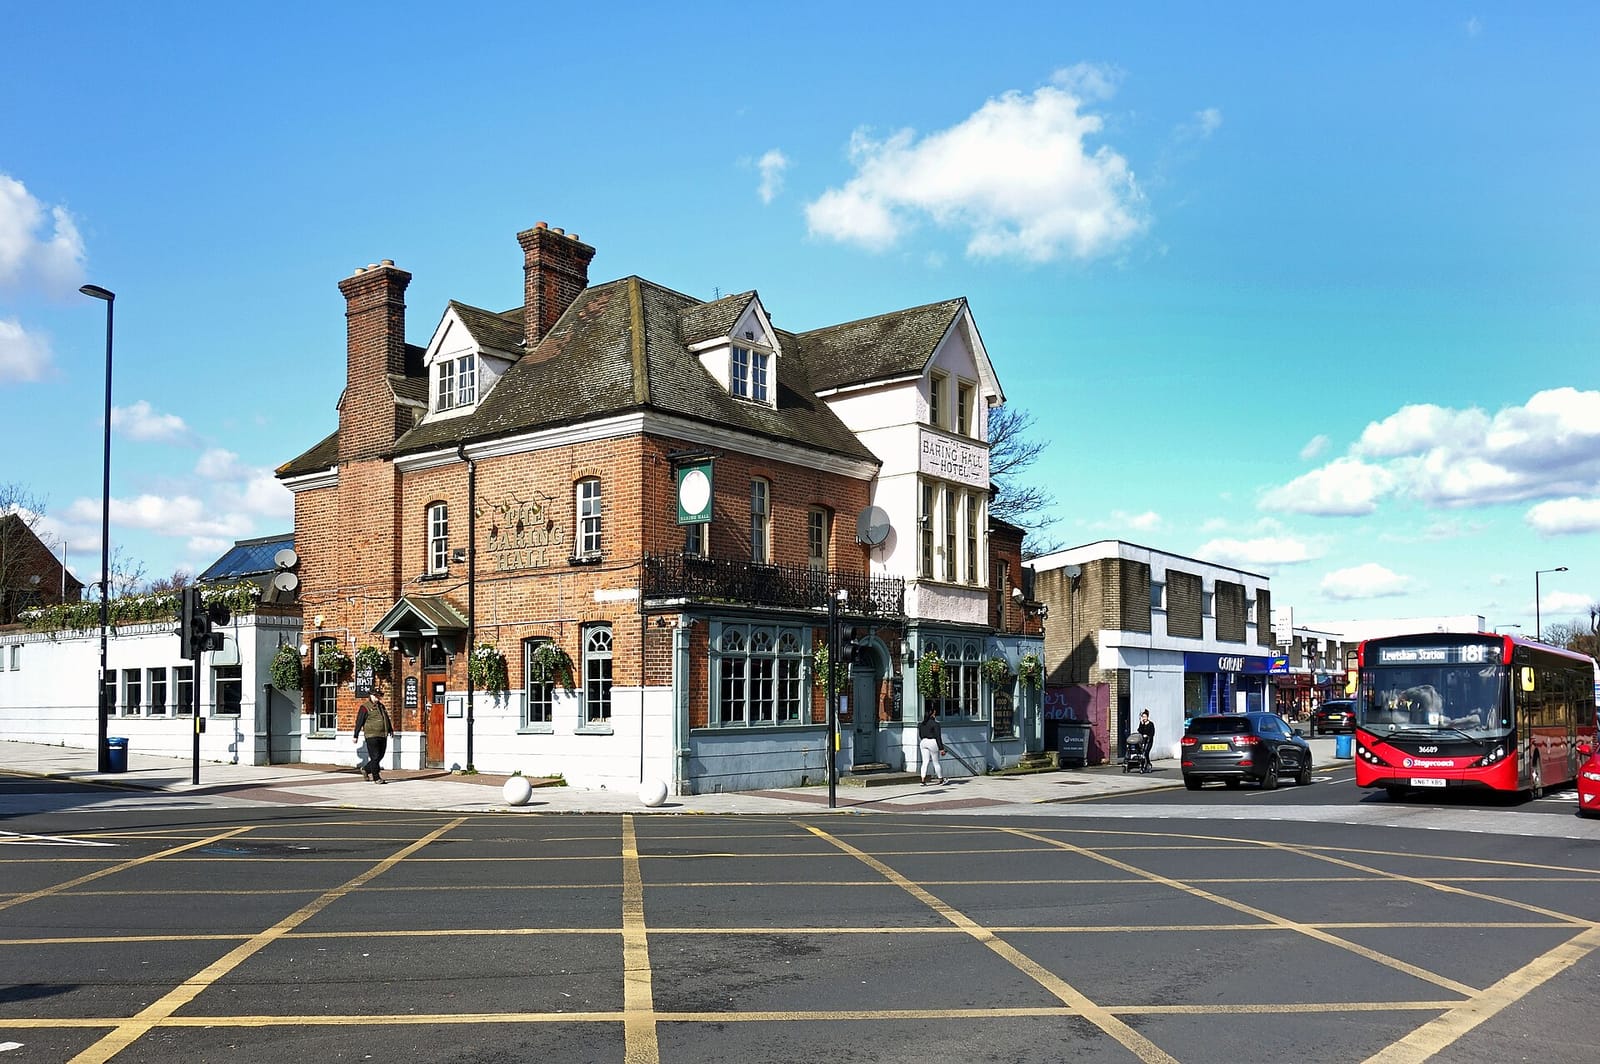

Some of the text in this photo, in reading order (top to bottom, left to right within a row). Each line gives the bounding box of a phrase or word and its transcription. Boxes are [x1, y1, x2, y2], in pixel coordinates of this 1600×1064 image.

[923, 440, 983, 469] BARING HALL
[504, 503, 545, 529] THE
[486, 525, 565, 553] BARING
[495, 547, 550, 572] HALL
[1218, 656, 1244, 671] CORAL
[1382, 645, 1485, 662] Lewisham Station 181
[1413, 759, 1455, 769] Stagecoach
